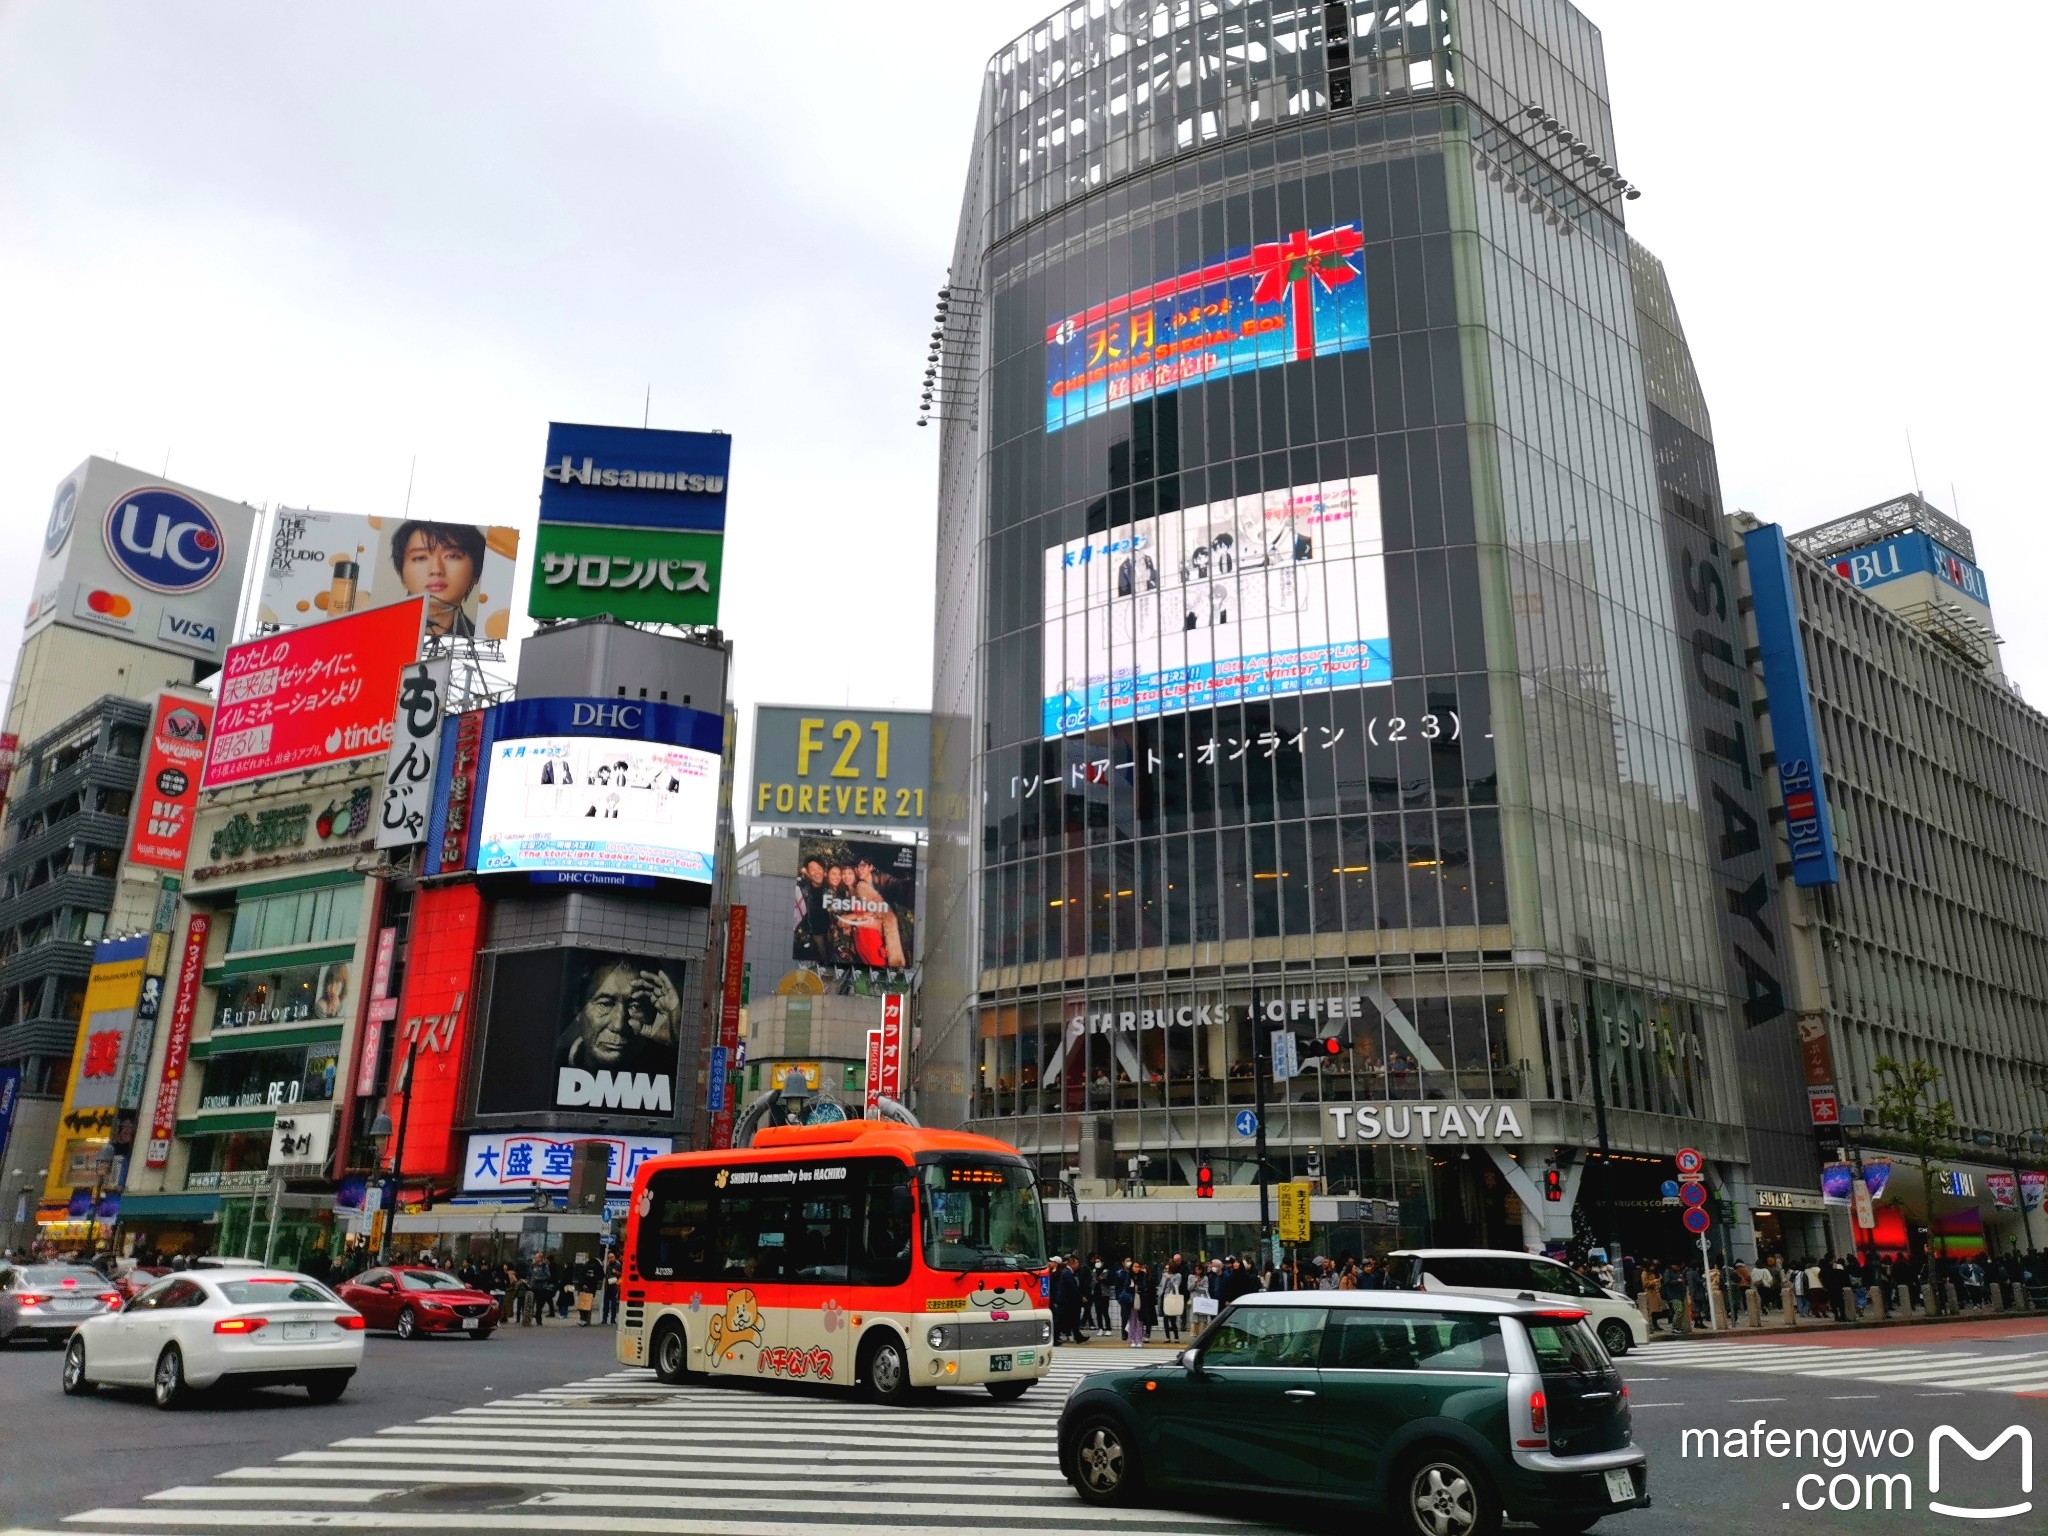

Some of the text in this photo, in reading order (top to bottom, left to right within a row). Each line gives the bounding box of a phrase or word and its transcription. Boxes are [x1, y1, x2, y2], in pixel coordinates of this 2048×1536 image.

[1087, 309, 1155, 366] 天月
[1052, 316, 1286, 398] CHRISTMAS SPECIAL BOX
[543, 456, 724, 493] Hisamitsu
[276, 529, 306, 539] ART
[280, 518, 306, 528] THE
[273, 548, 325, 562] STUDIO
[275, 538, 294, 548] OF
[271, 558, 292, 571] FIX
[541, 551, 710, 593] サロンパス
[168, 615, 216, 642] VISA
[230, 641, 290, 673] わたしの
[1335, 644, 1368, 658] Live
[218, 679, 363, 731] イルミネーションより
[571, 702, 642, 729] DHC
[214, 727, 270, 762] 明るい。
[344, 716, 396, 750] tinde
[798, 718, 889, 779] F21
[380, 663, 441, 839] もんじゃ
[152, 801, 184, 819] B1F
[758, 783, 923, 817] FOREVER 21
[1781, 759, 1822, 861] SEIBU
[148, 820, 182, 838] B2F
[557, 872, 626, 885] DHC Channel
[822, 894, 889, 913] Fashion
[222, 1002, 309, 1026] Euphoria
[1071, 997, 1363, 1035] STARBUCKS COFFEE
[883, 1005, 899, 1077] カラオケ
[1602, 1016, 1703, 1061] TSUTAYA
[557, 1067, 671, 1111] DMM
[1329, 1105, 1523, 1139] TSUTAYA
[730, 1167, 847, 1184] SHIBUYA community bus HACHIKO
[1756, 1191, 1793, 1207] TSUTAYA
[757, 1345, 834, 1380] ハチ公バス
